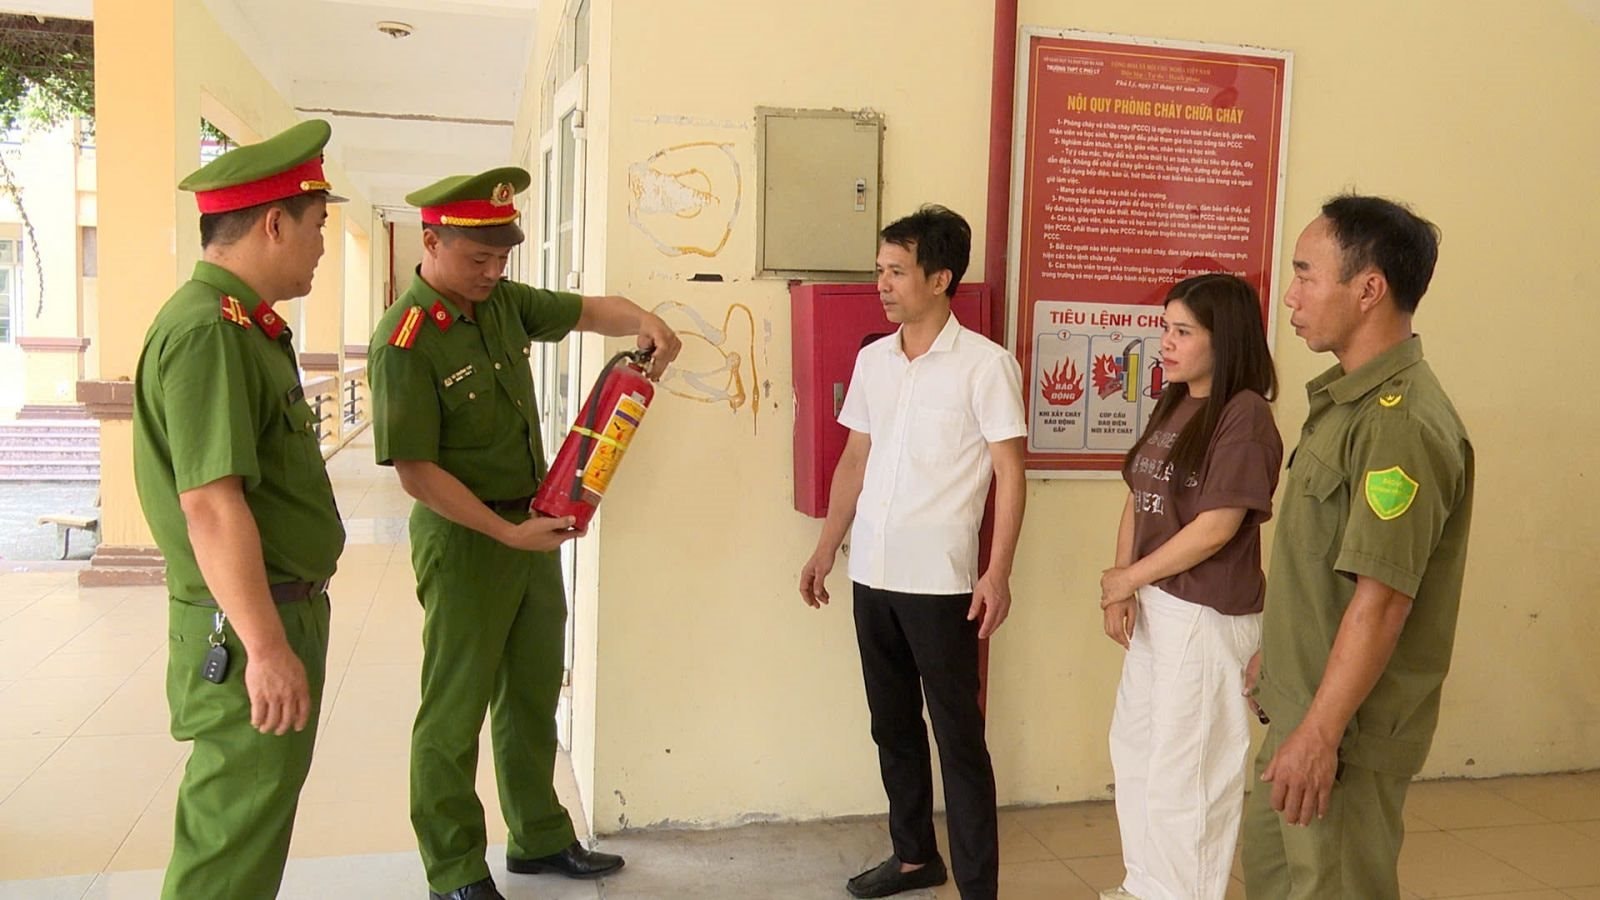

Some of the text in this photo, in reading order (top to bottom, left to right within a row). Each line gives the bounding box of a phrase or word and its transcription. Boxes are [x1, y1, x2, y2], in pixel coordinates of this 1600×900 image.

[1068, 93, 1244, 124] NỘI QUY PHÒNG CHÁY CHỮA CHÁY
[1050, 308, 1167, 330] TIÊU LỆNH CH
[1056, 382, 1073, 390] BÁO
